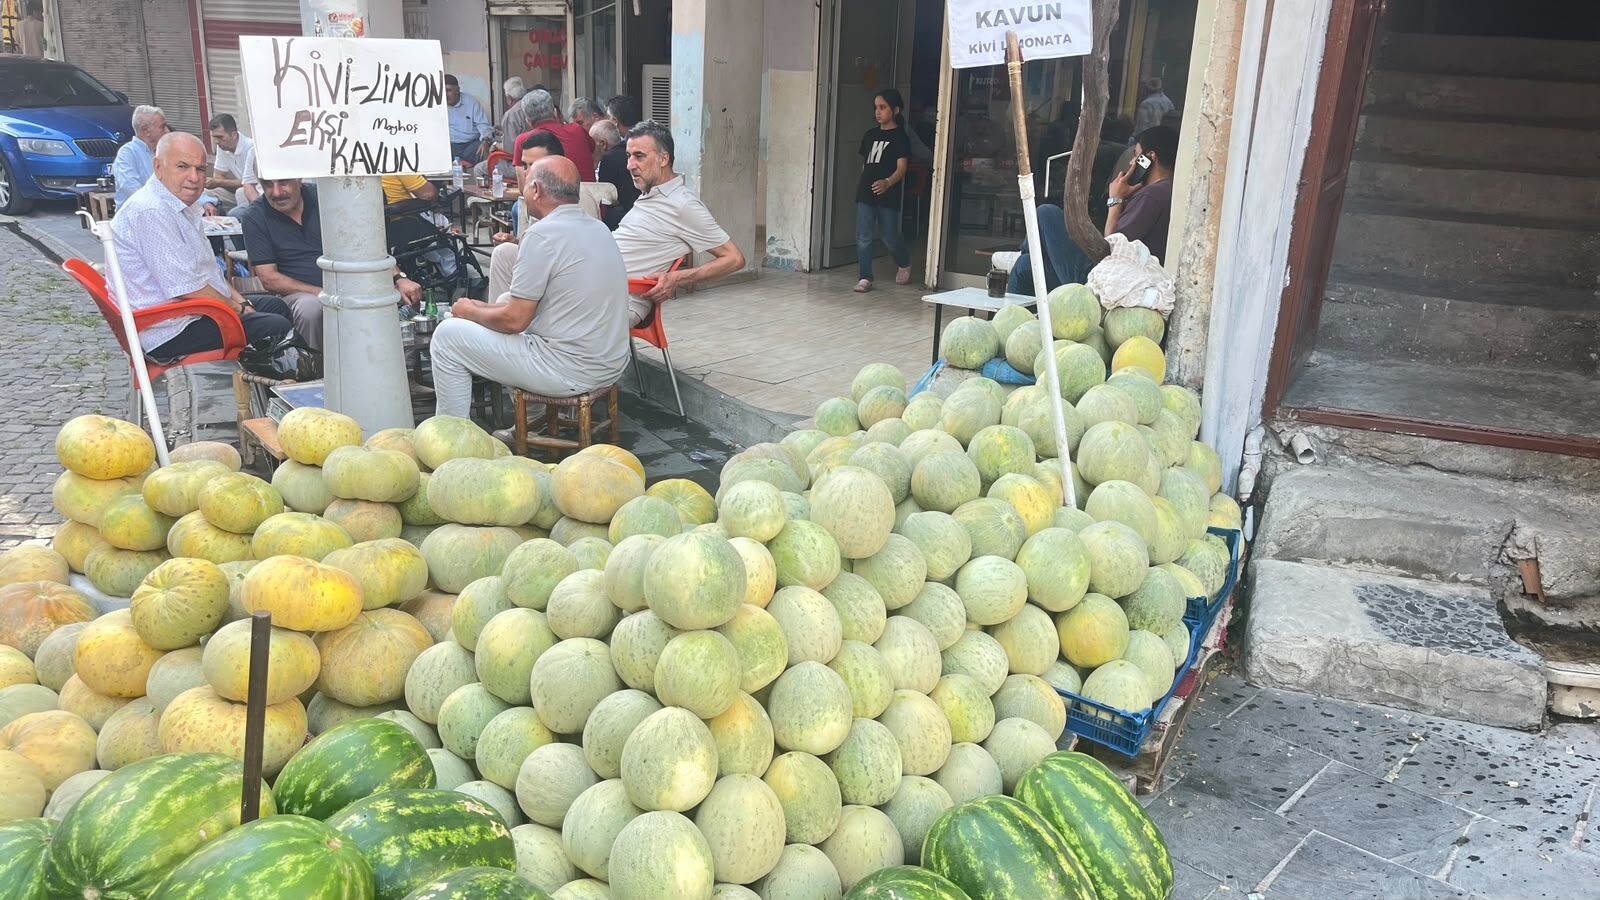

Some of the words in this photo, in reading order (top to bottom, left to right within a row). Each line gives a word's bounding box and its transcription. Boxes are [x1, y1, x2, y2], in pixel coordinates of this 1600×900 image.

[976, 3, 1062, 29] KAVUN
[969, 40, 996, 55] KİVİ
[1001, 34, 1072, 51] LONATA
[523, 52, 568, 71] ÇAYEV
[279, 110, 349, 150] EKŞİ
[330, 137, 419, 175] KAVUN
